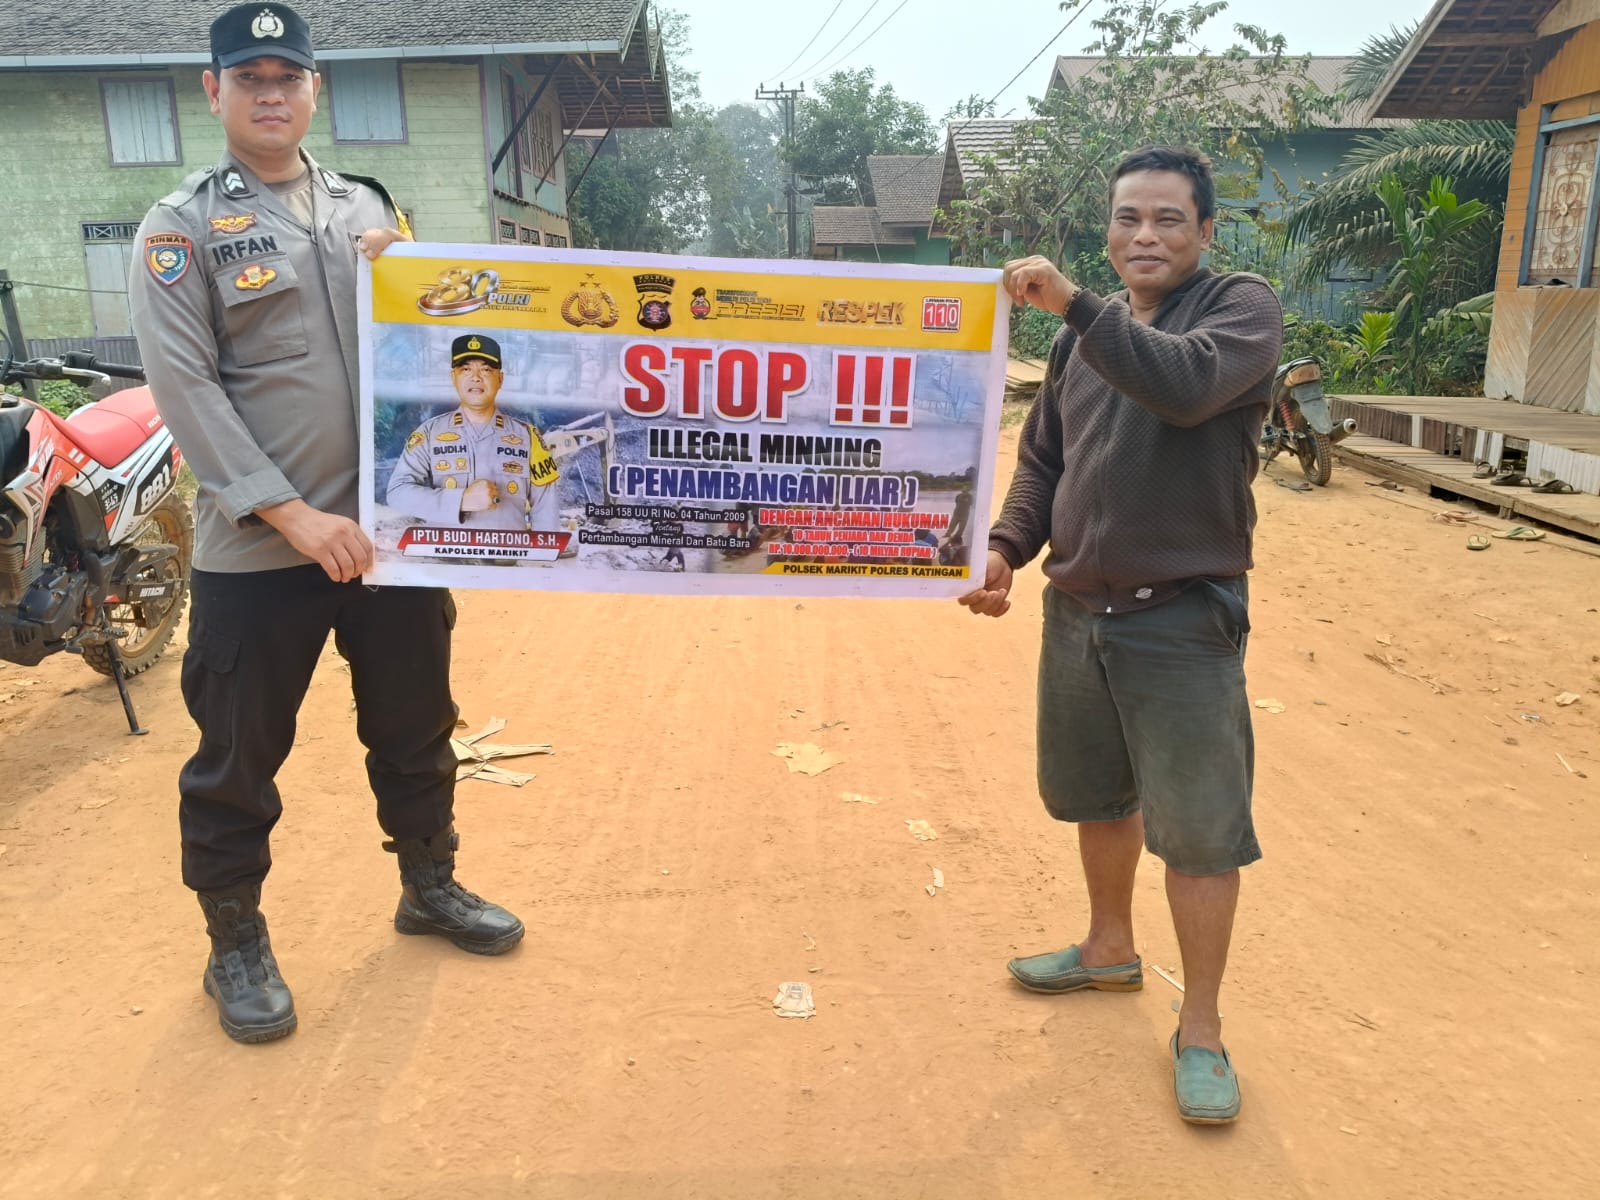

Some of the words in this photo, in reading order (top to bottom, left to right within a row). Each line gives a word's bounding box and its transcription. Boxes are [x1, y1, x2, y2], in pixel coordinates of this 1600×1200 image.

[212, 235, 277, 265] IRFAN
[427, 266, 500, 305] 80
[487, 292, 531, 306] POLRI
[818, 299, 904, 325] RESPEK
[925, 304, 958, 327] 110
[623, 343, 808, 419] STOP
[834, 353, 912, 425] !!!
[433, 445, 467, 455] BUDI.H
[497, 446, 528, 459] POLRI
[649, 428, 753, 463] ILLEGAL
[759, 433, 881, 468] MINNING
[140, 462, 171, 513] 881
[627, 466, 836, 505] PENAMBANGAN
[839, 475, 902, 505] LIAR
[588, 505, 614, 516] Pasal
[616, 507, 632, 517] 158
[634, 508, 649, 518] UU
[651, 509, 660, 518] RI
[663, 509, 679, 519] No.
[681, 510, 691, 519] 04
[693, 510, 722, 521] Tahun
[723, 511, 745, 522] 2009
[759, 509, 813, 525] DENGAN
[815, 510, 882, 528] ANCAMAN
[883, 512, 950, 530] HUKUMAN
[412, 529, 439, 542] IPTU
[443, 530, 472, 543] BUDI
[475, 531, 534, 546] HARTONO,
[537, 533, 560, 547] S.H.
[581, 532, 648, 545] Pertambangan
[650, 534, 684, 546] Mineral
[686, 536, 704, 546] Dan
[706, 536, 728, 547] Batu
[729, 537, 750, 548] Bara
[804, 530, 832, 543] TAHUN
[434, 547, 485, 556] KAPOLSEK
[488, 548, 528, 557] MARIKIT
[783, 564, 823, 574] POLSEK
[826, 565, 866, 575] MARIKIT
[870, 566, 908, 576] POLRES
[912, 567, 963, 577] KATINGAN
